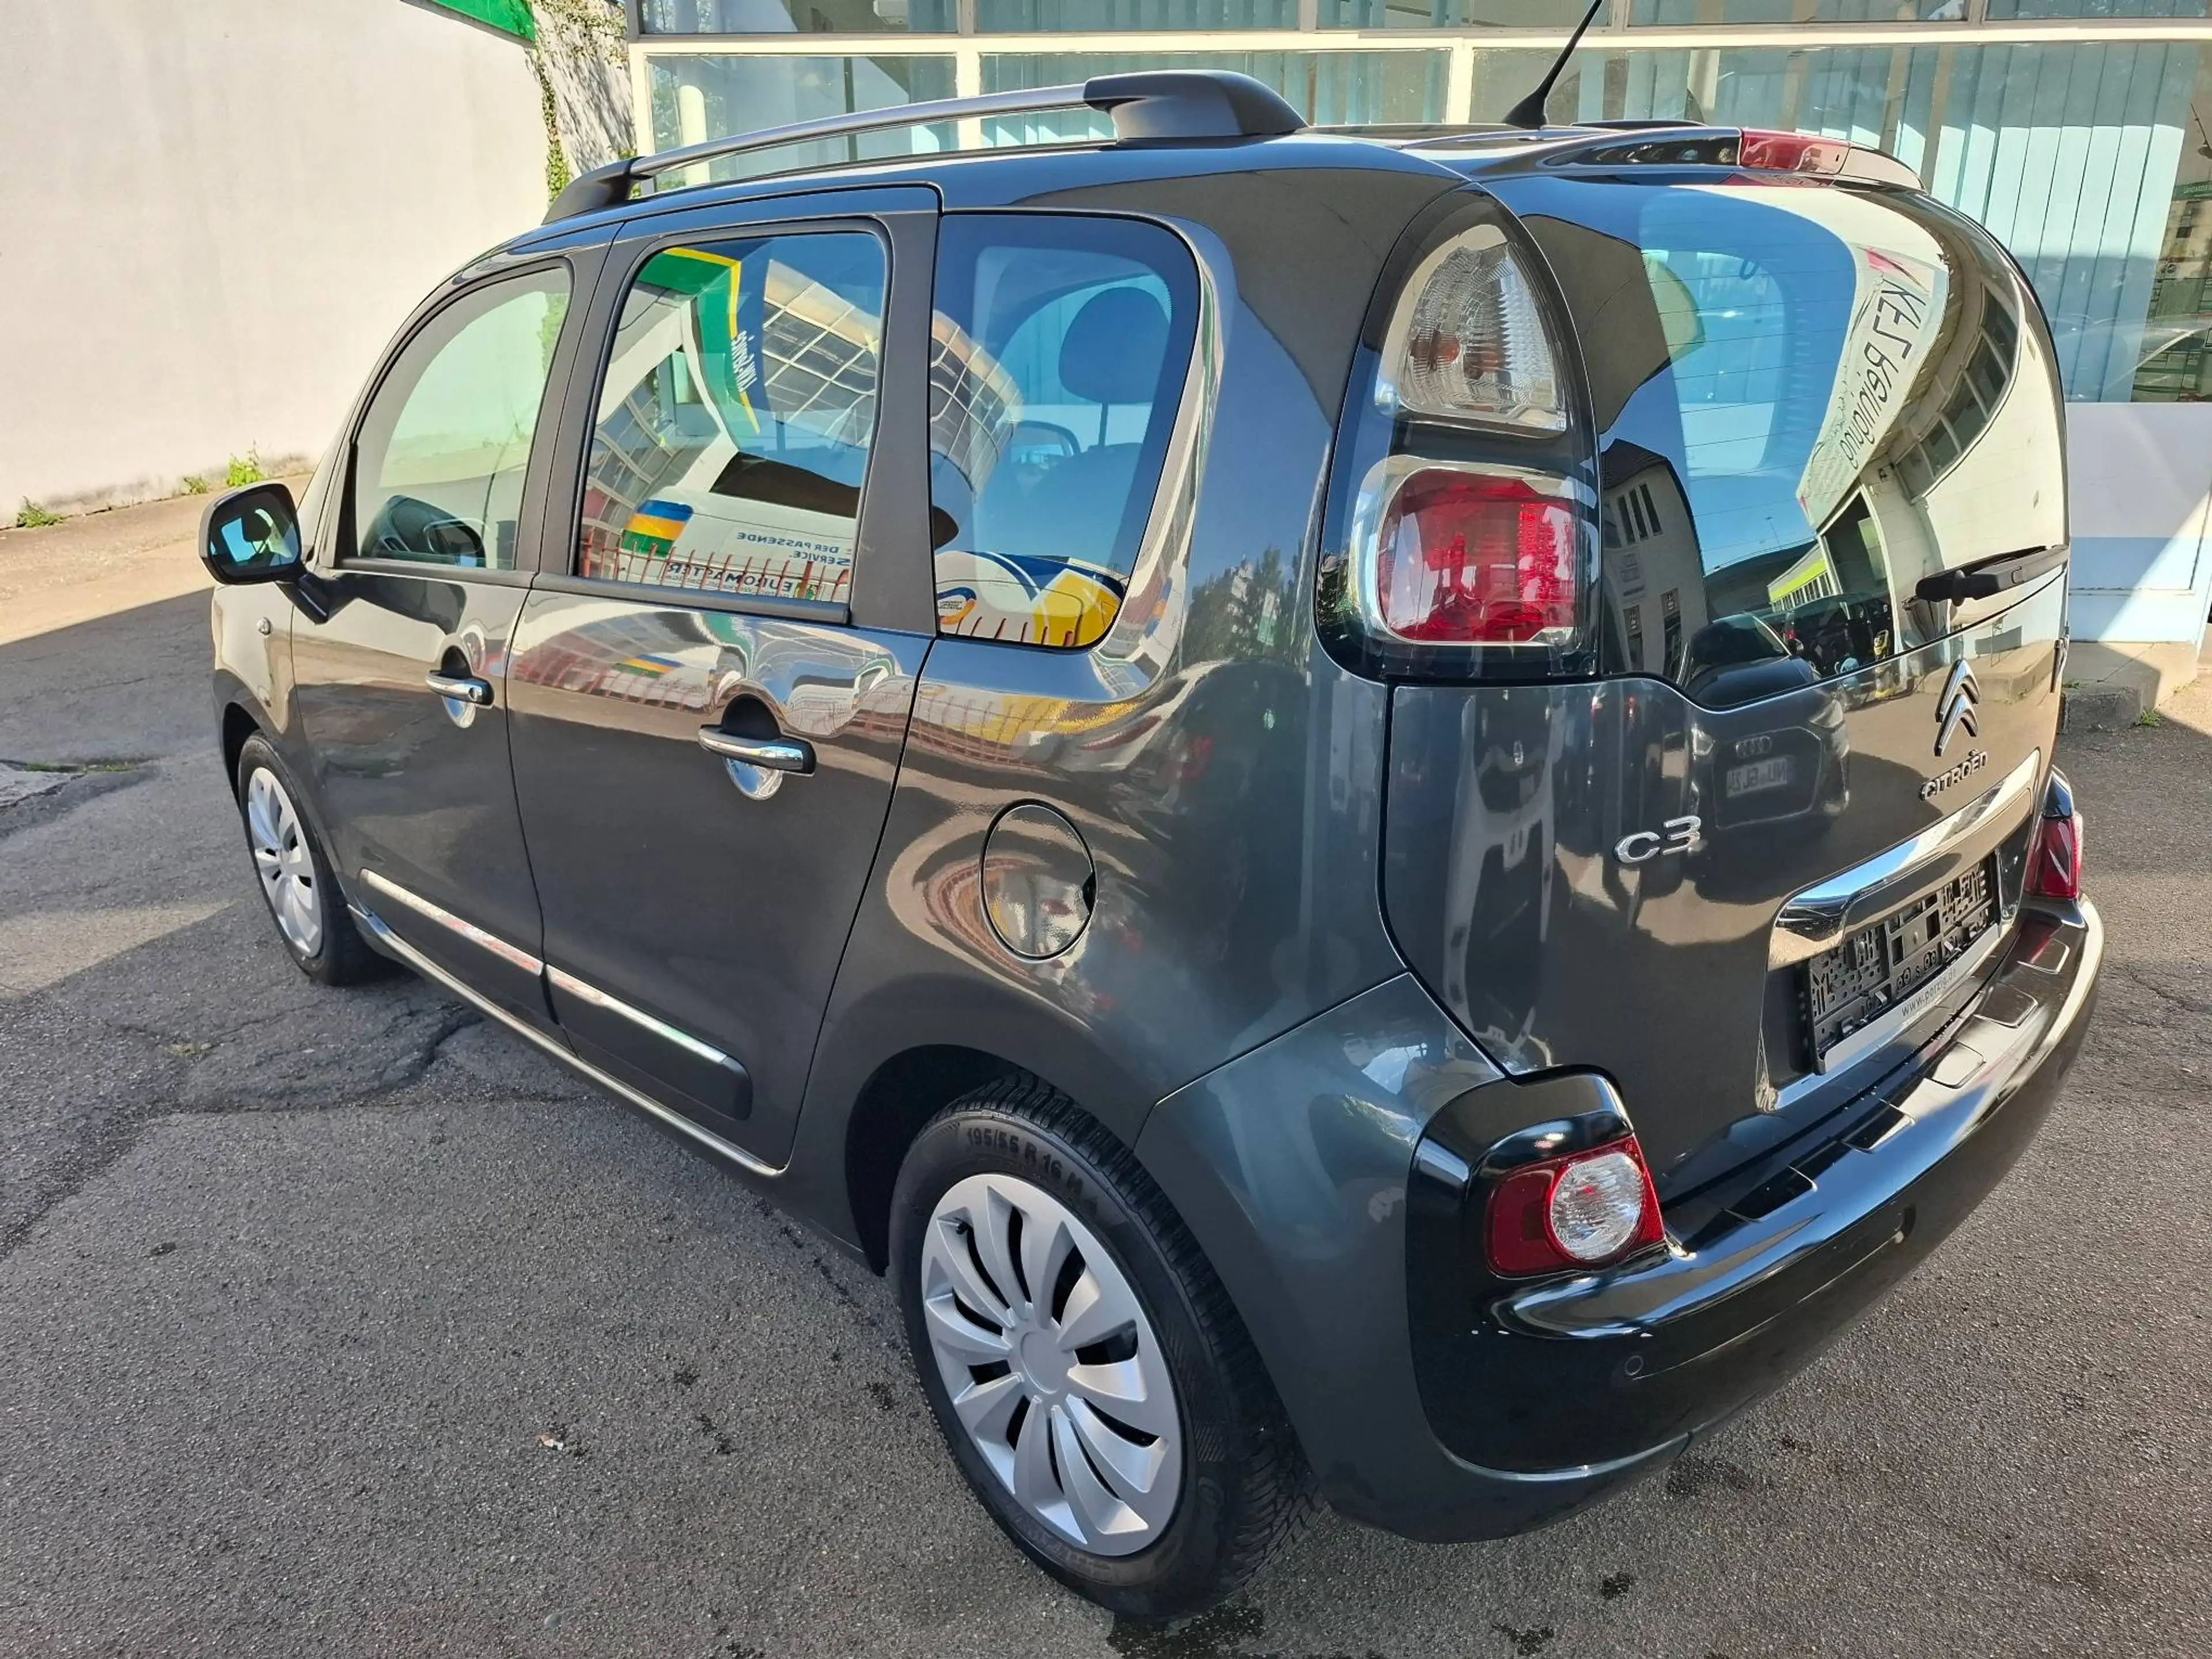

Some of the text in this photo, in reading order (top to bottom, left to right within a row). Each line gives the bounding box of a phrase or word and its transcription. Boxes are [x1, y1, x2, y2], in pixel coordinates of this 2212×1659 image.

[1613, 815, 1701, 863] C3
[967, 1127, 1020, 1153] 195/55
[1043, 1153, 1062, 1180] 16
